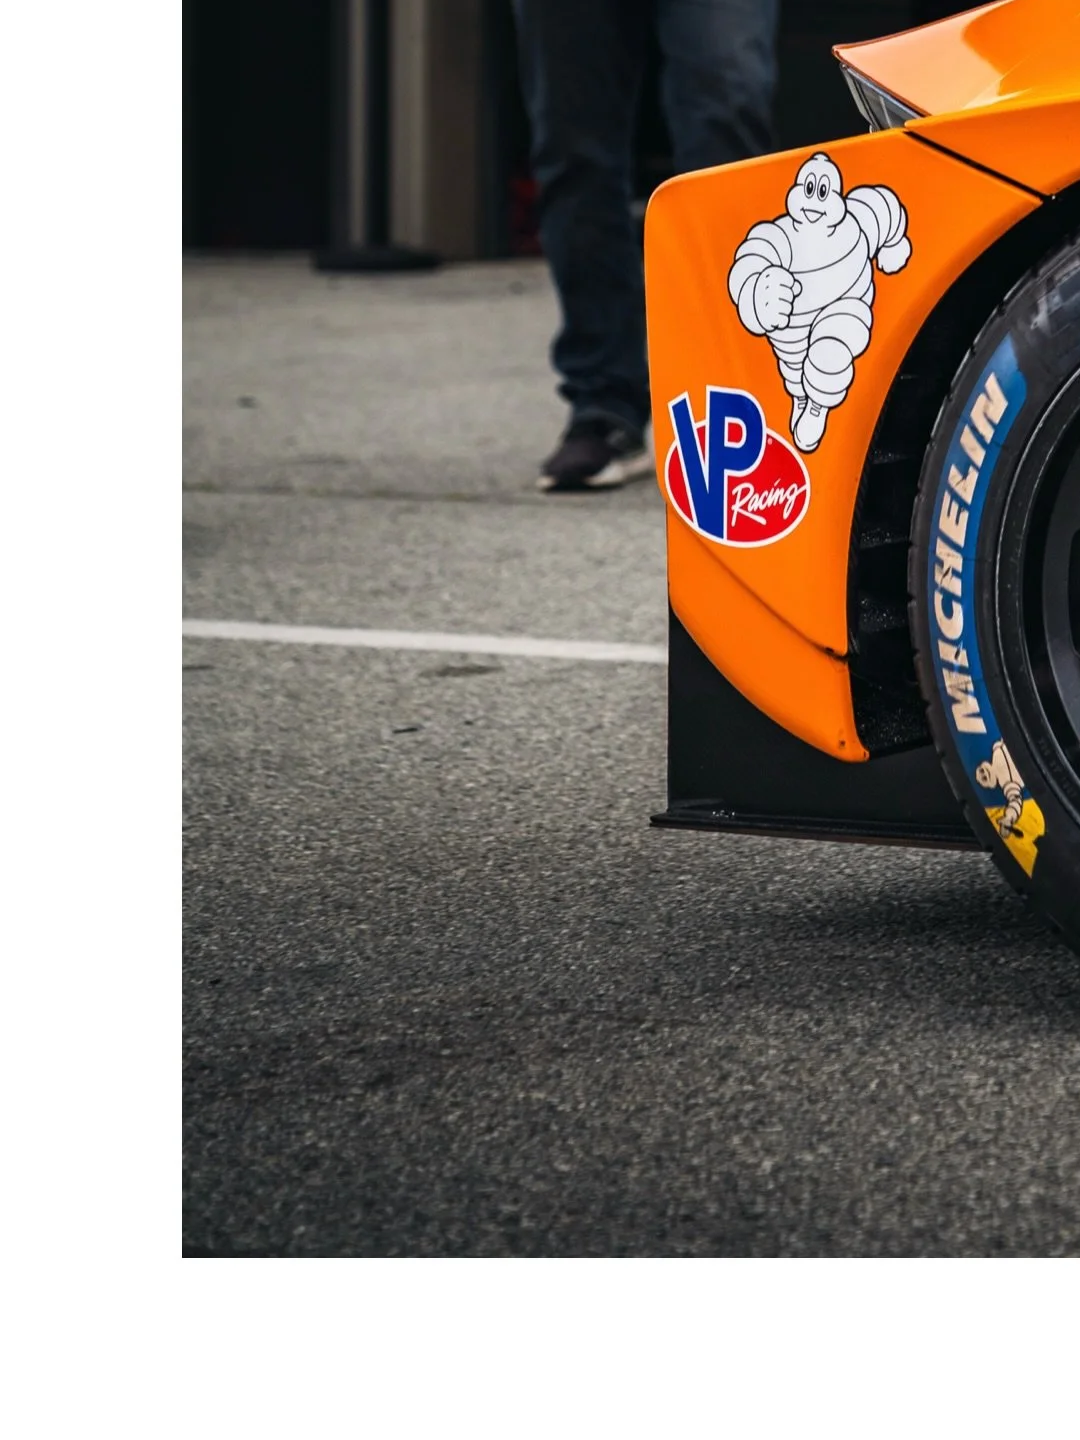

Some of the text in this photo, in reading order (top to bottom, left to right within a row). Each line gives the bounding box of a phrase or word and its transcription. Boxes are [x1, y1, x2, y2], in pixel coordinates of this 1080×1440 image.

[668, 385, 766, 542] VP
[731, 478, 806, 528] Racing
[932, 371, 1010, 736] MICHELIN
